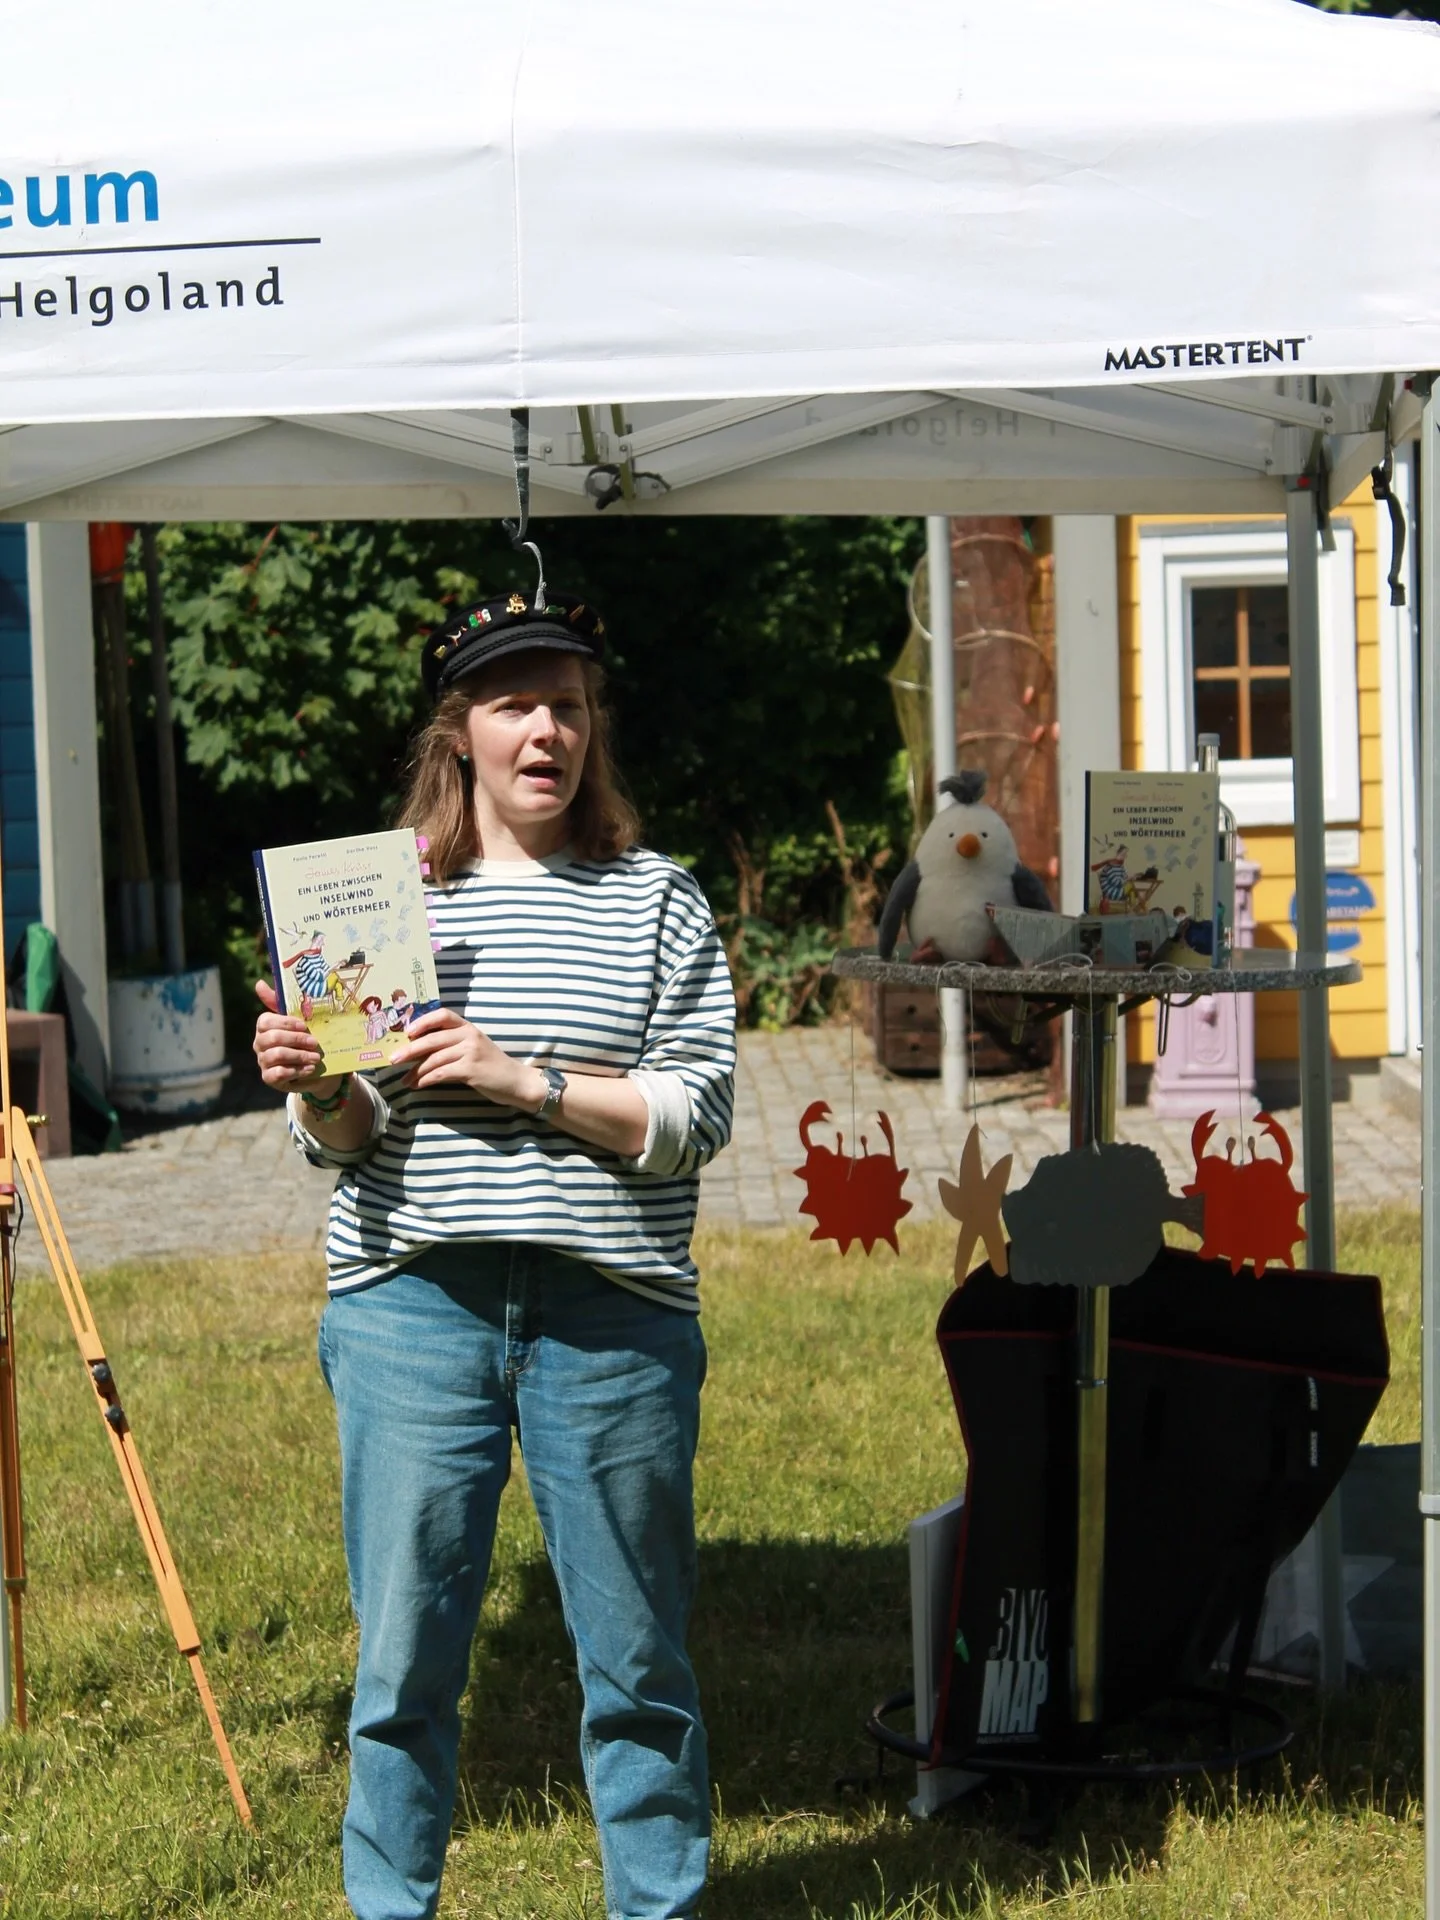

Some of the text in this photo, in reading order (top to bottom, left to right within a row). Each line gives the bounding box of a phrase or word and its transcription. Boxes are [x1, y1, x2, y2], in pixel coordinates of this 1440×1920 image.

[0, 265, 285, 327] Helgoland
[1104, 337, 1306, 371] MASTERTENT
[1112, 805, 1184, 814] EIN LEBEN ZWISCHEN
[1129, 816, 1175, 825] INSELWIND
[1130, 827, 1186, 838] WÖRTERMEER
[298, 872, 383, 896] EIN LEBEN ZWISCHEN
[319, 887, 374, 905] INSELWIND
[303, 900, 391, 923] UND WÖRTERMEER
[978, 1660, 1049, 1734] MAP
